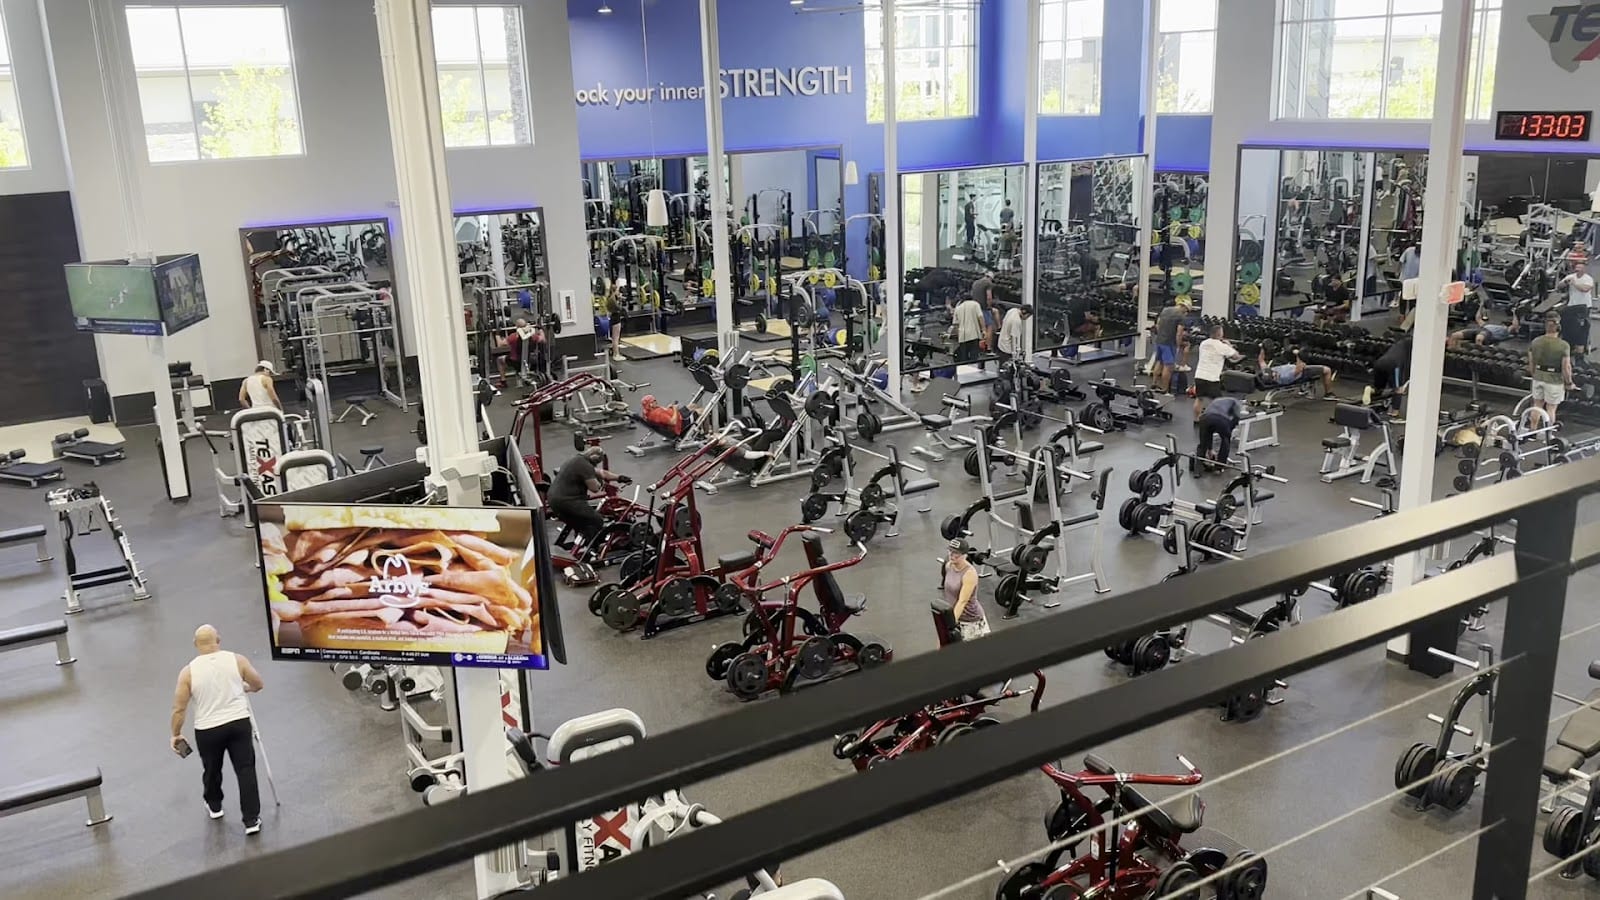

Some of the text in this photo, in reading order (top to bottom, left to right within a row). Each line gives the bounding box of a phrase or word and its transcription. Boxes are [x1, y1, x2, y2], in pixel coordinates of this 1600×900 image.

[576, 65, 852, 107] ock your inner STRENGTH
[256, 439, 277, 495] TEXAS
